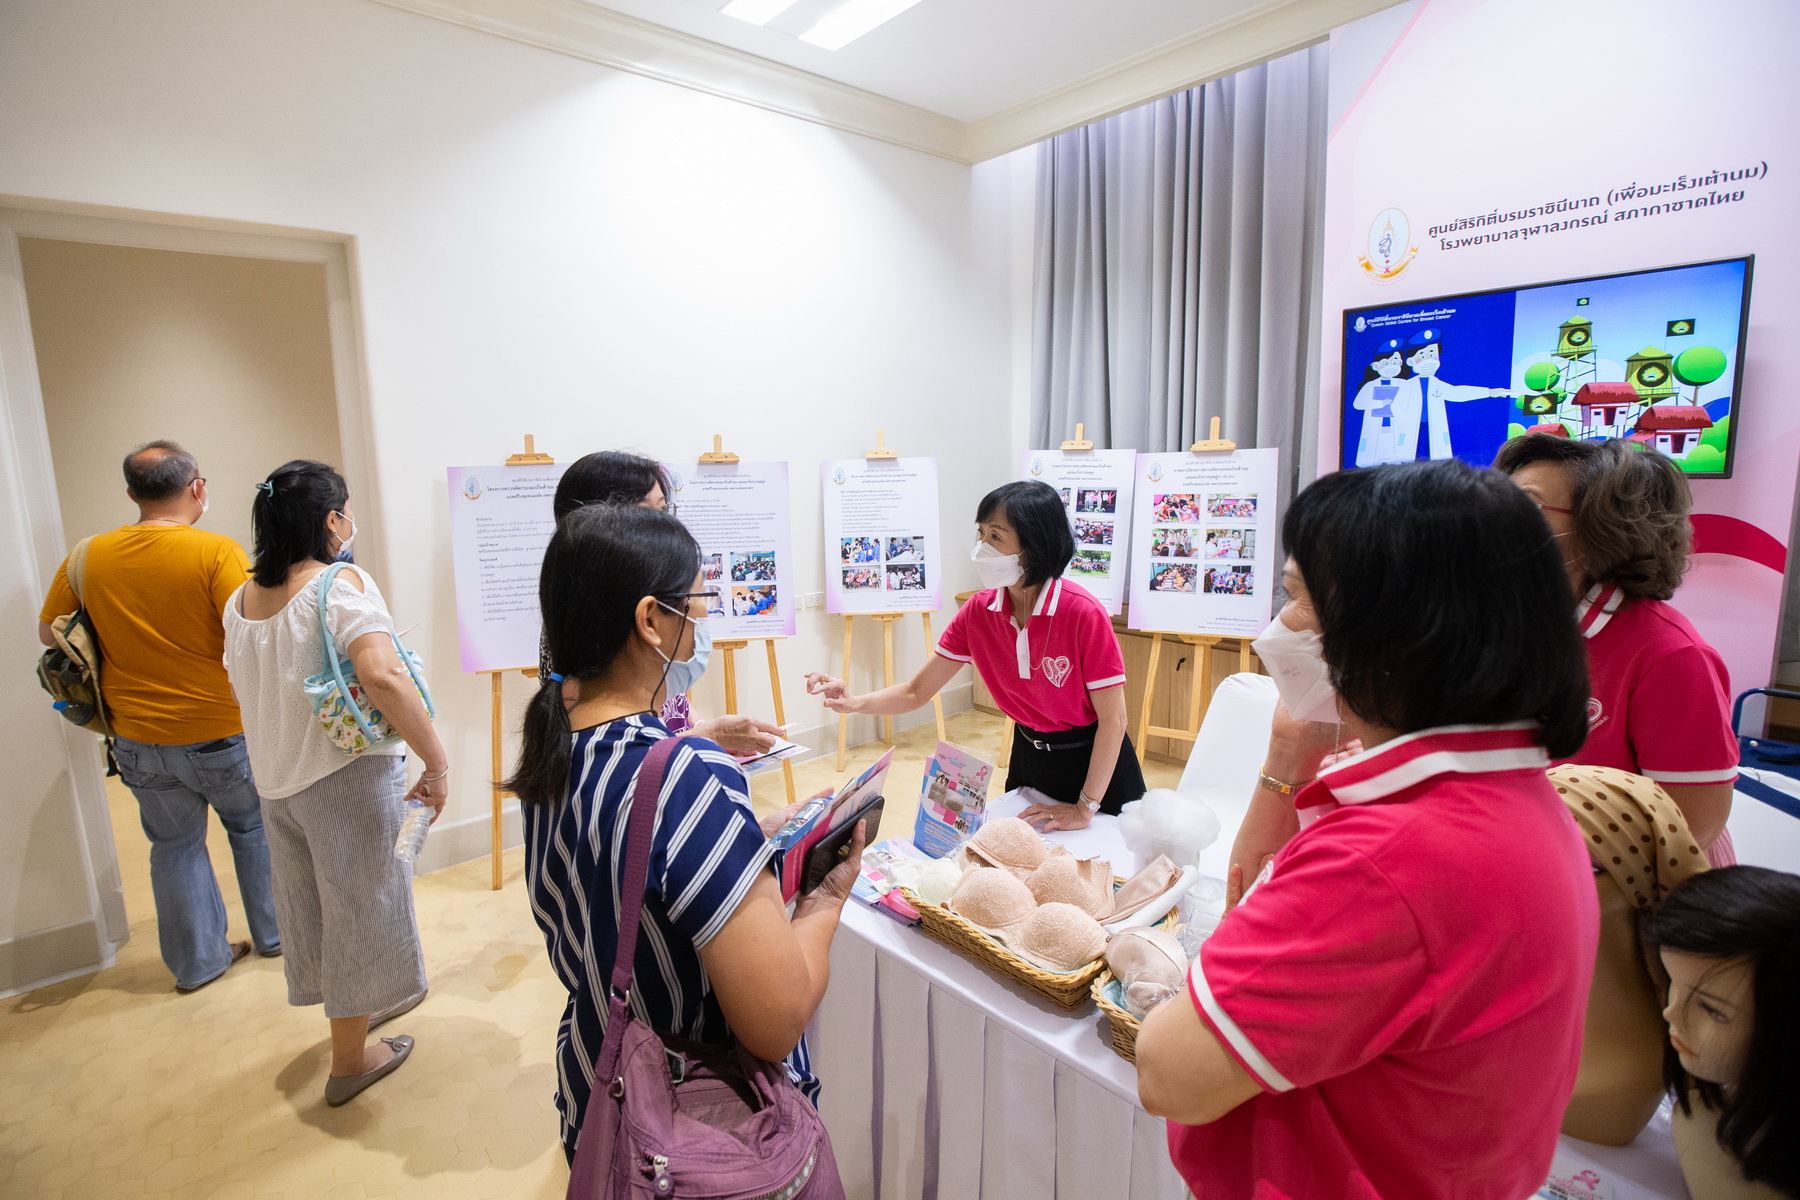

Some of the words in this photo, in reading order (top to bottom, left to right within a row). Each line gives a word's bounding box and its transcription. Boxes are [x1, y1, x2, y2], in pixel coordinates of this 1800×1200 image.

[1428, 195, 1600, 239] ศูนย์สิริกิติ์บรมราชินีนาถ
[1607, 160, 1769, 207] (เพื่อมะเร็งเต้านม)
[1440, 210, 1608, 251] โรงพยาบาลจุฬาลงกรณ์
[1614, 188, 1745, 222] สภากาชาดไทย
